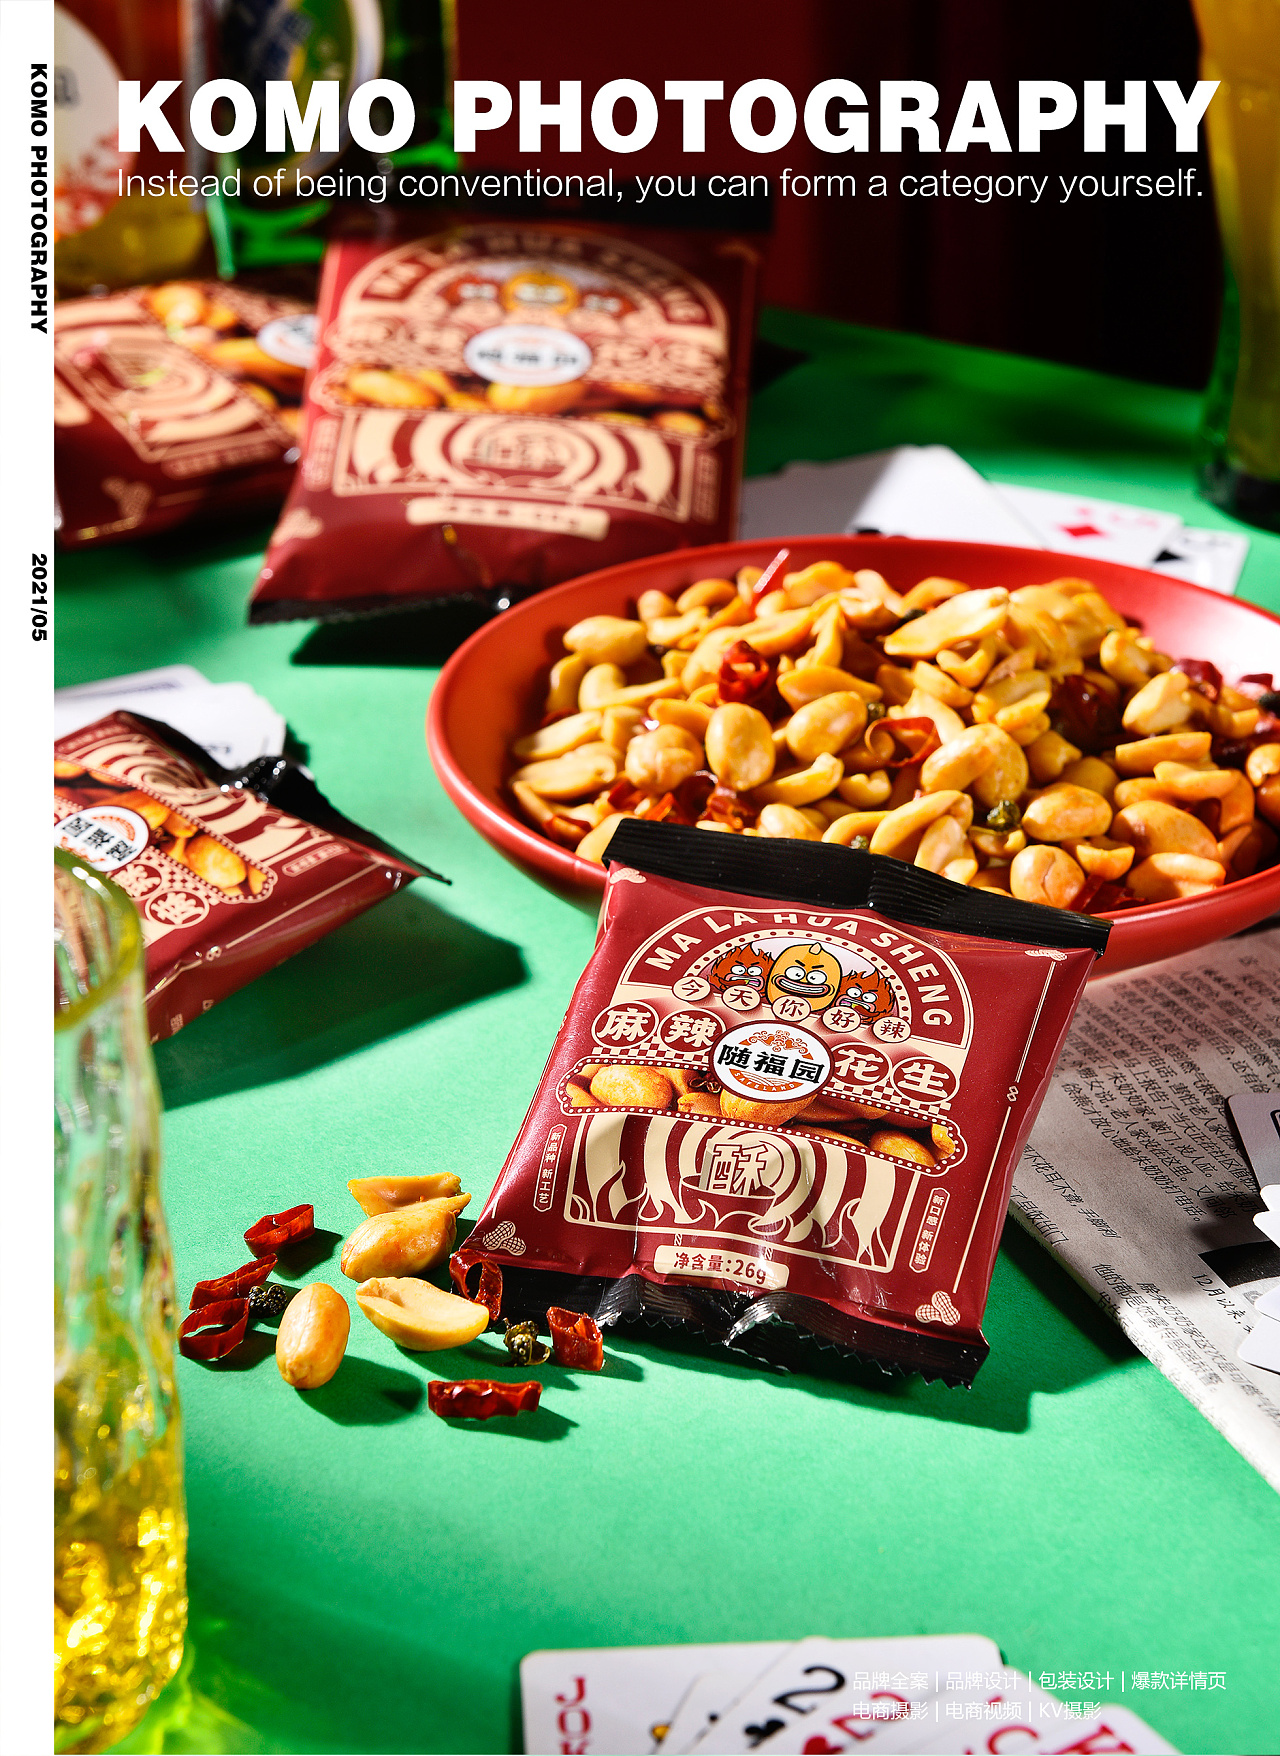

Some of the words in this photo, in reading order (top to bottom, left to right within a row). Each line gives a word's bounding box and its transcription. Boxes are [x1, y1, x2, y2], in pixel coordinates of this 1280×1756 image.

[644, 931, 703, 972] MA
[702, 911, 759, 935] LA
[772, 912, 859, 937] HUA
[869, 931, 953, 1027] SHENG
[716, 1043, 826, 1084] 随福园
[706, 1143, 770, 1197] 酥
